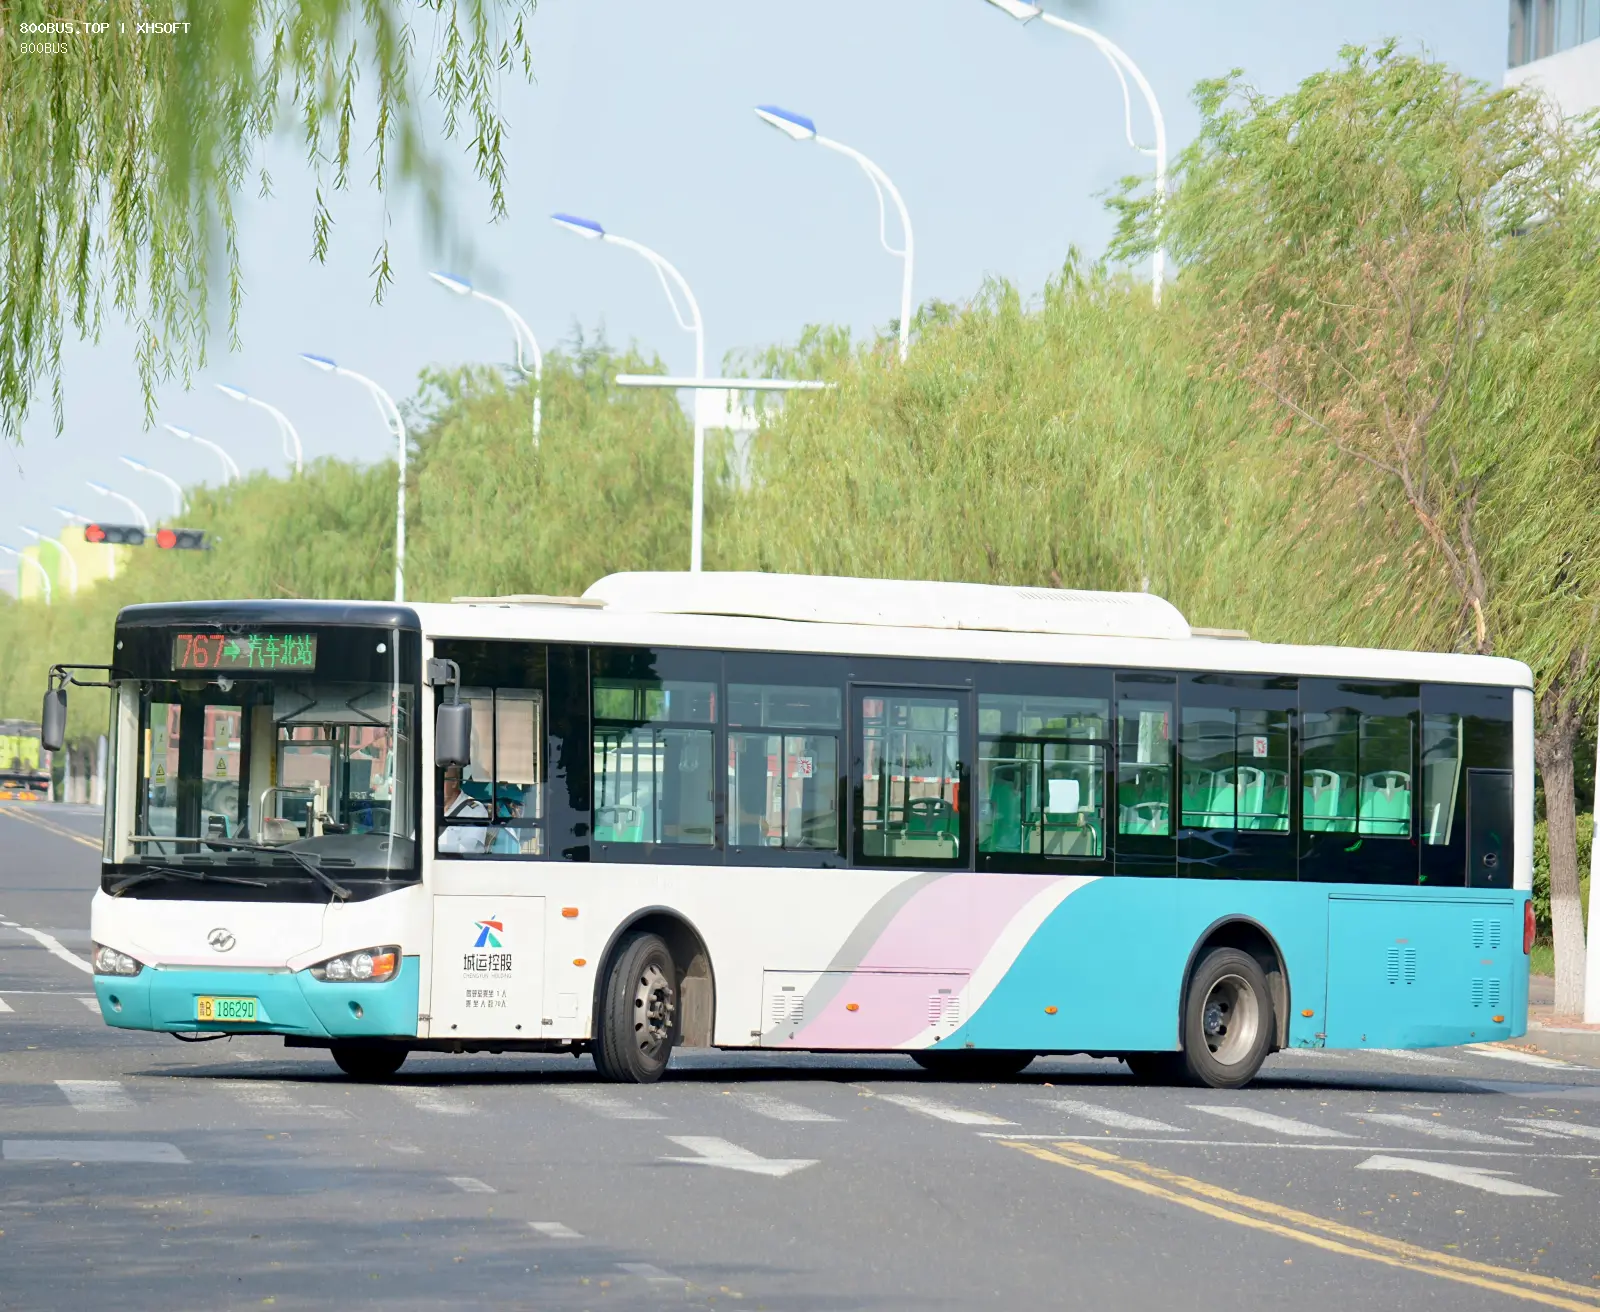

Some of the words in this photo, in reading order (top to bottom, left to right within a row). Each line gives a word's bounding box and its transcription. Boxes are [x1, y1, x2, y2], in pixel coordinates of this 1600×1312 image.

[177, 634, 225, 668] 767
[248, 634, 312, 668] 汽车北站
[463, 954, 512, 971] 城运控股
[217, 1001, 254, 1018] 18629D
